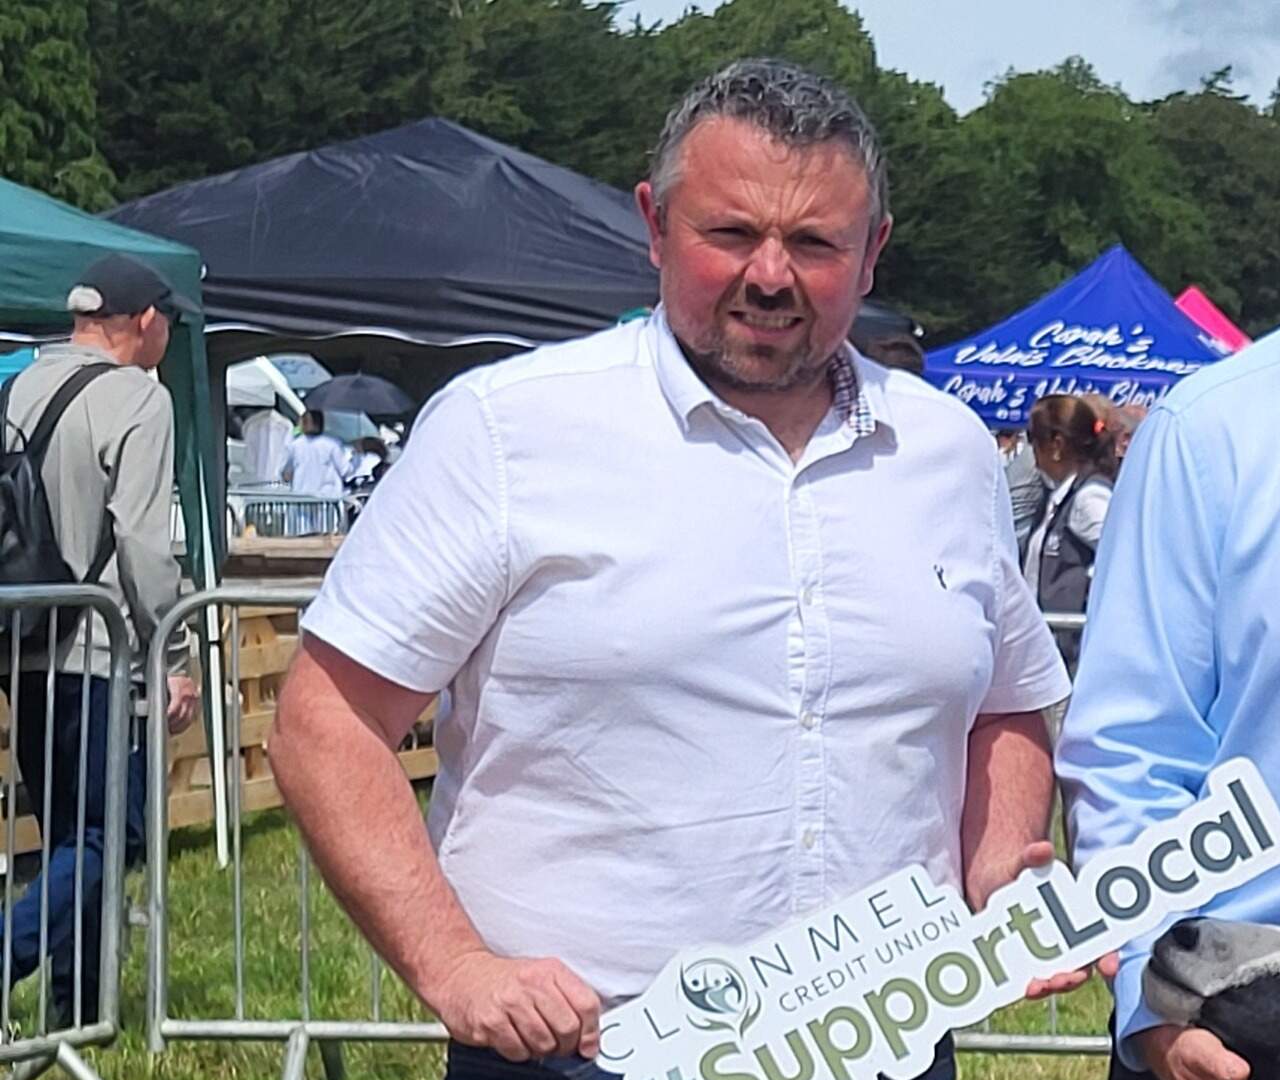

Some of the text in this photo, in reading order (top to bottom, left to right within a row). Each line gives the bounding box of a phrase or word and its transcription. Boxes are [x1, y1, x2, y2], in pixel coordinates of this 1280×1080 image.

[1050, 346, 1203, 375] Blacknos
[779, 909, 962, 1013] CREDIT UNION
